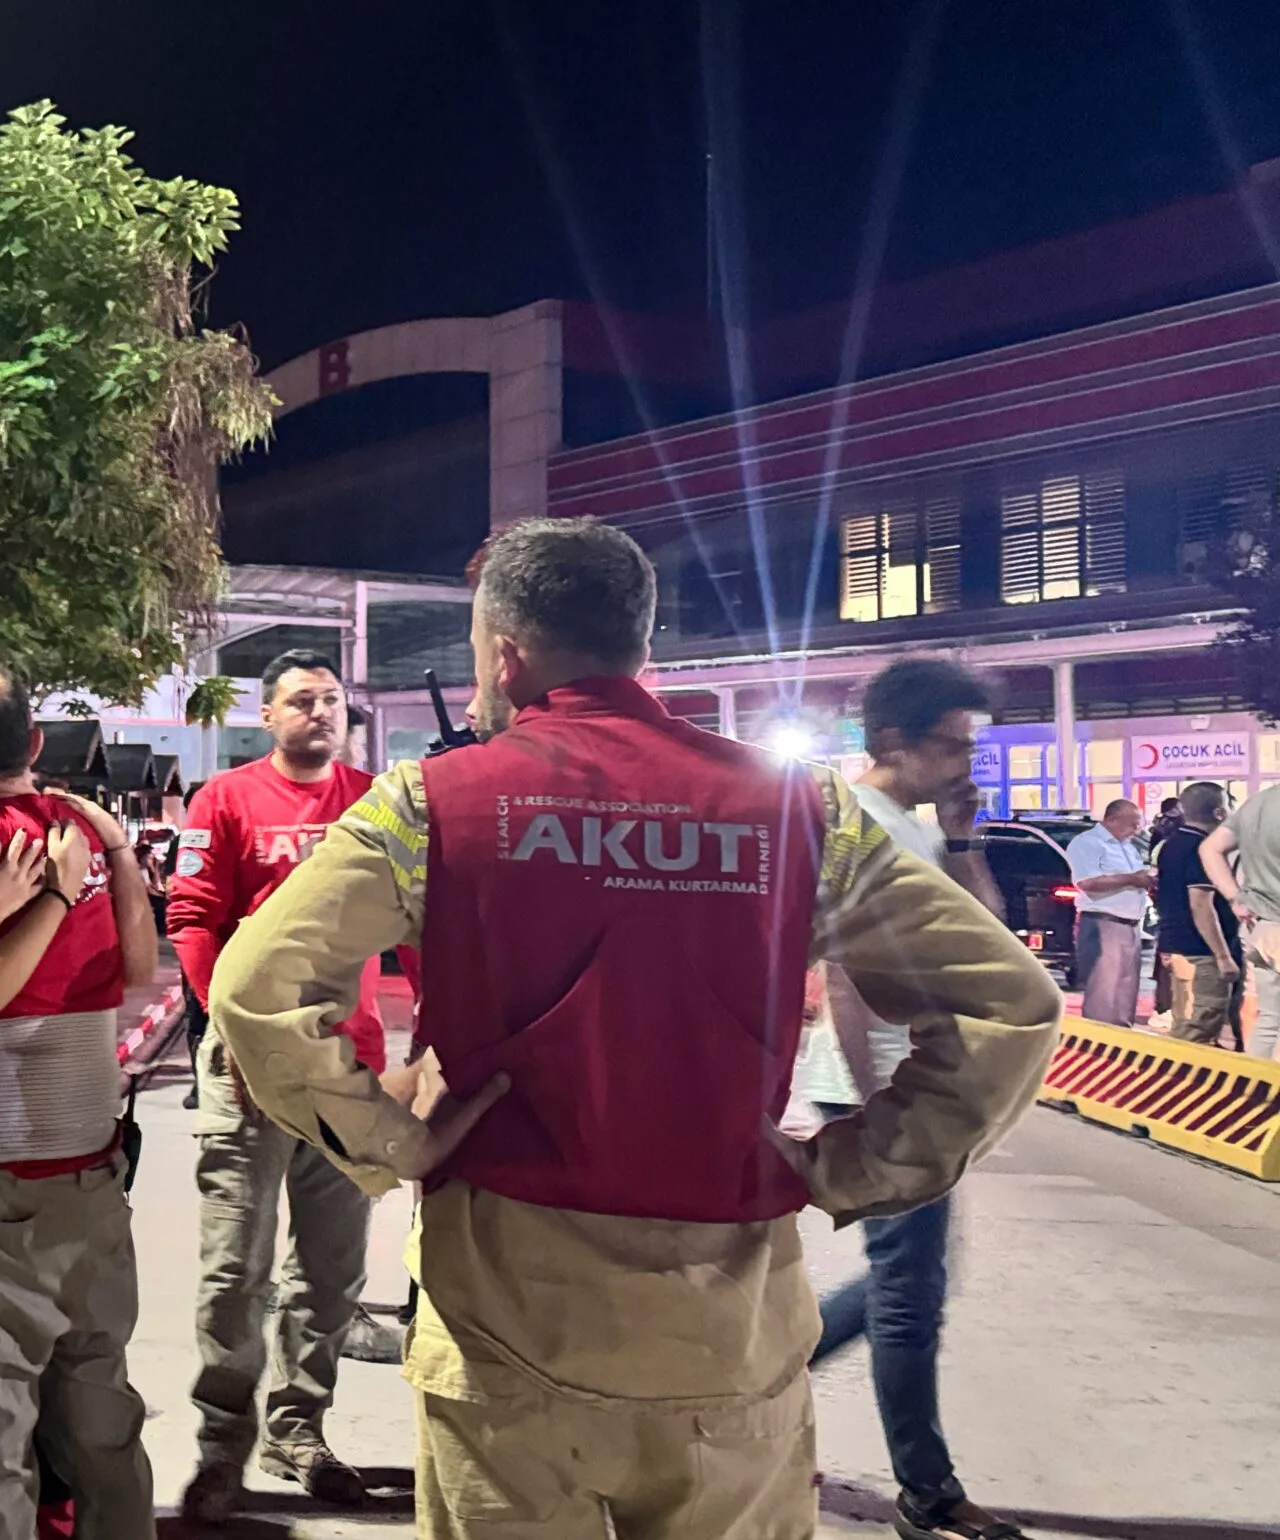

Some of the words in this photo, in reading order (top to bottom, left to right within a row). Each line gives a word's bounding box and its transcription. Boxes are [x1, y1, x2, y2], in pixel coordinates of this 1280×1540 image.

[319, 341, 351, 396] B
[1162, 745, 1209, 760] ÇOCUK
[1214, 742, 1245, 756] ACİL
[525, 796, 583, 809] RESCUE
[588, 800, 692, 814] ASSOCIATION
[497, 795, 509, 860] SEARCH
[511, 814, 754, 873] AKUT
[603, 876, 666, 892] ARAMA
[669, 879, 759, 895] KURTARMA
